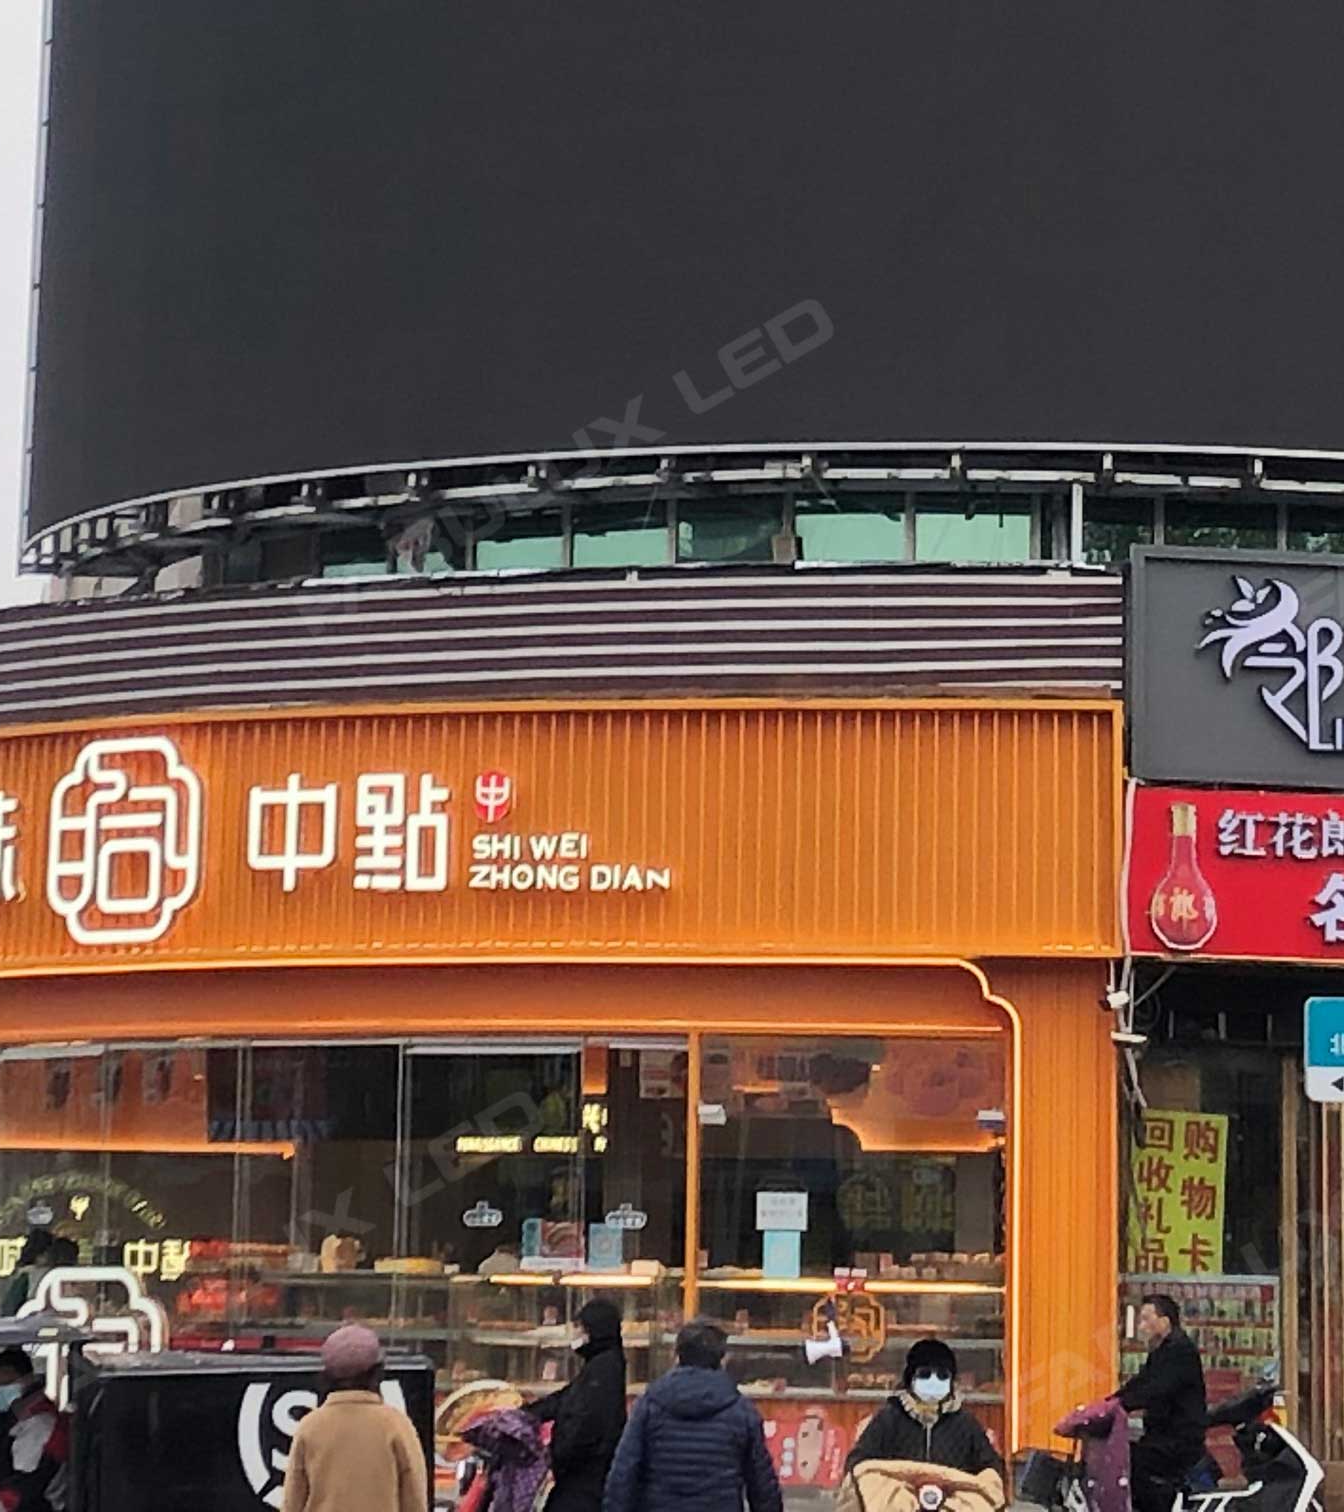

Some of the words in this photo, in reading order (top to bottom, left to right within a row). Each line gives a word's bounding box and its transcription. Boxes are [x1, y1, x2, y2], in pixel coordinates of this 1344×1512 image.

[471, 833, 520, 861] SHI
[528, 832, 589, 861] WEI
[468, 864, 581, 891] ZHONG
[590, 864, 672, 891] DIAN
[1135, 1119, 1174, 1274] 回收礼品
[1178, 1120, 1219, 1273] 购物卡
